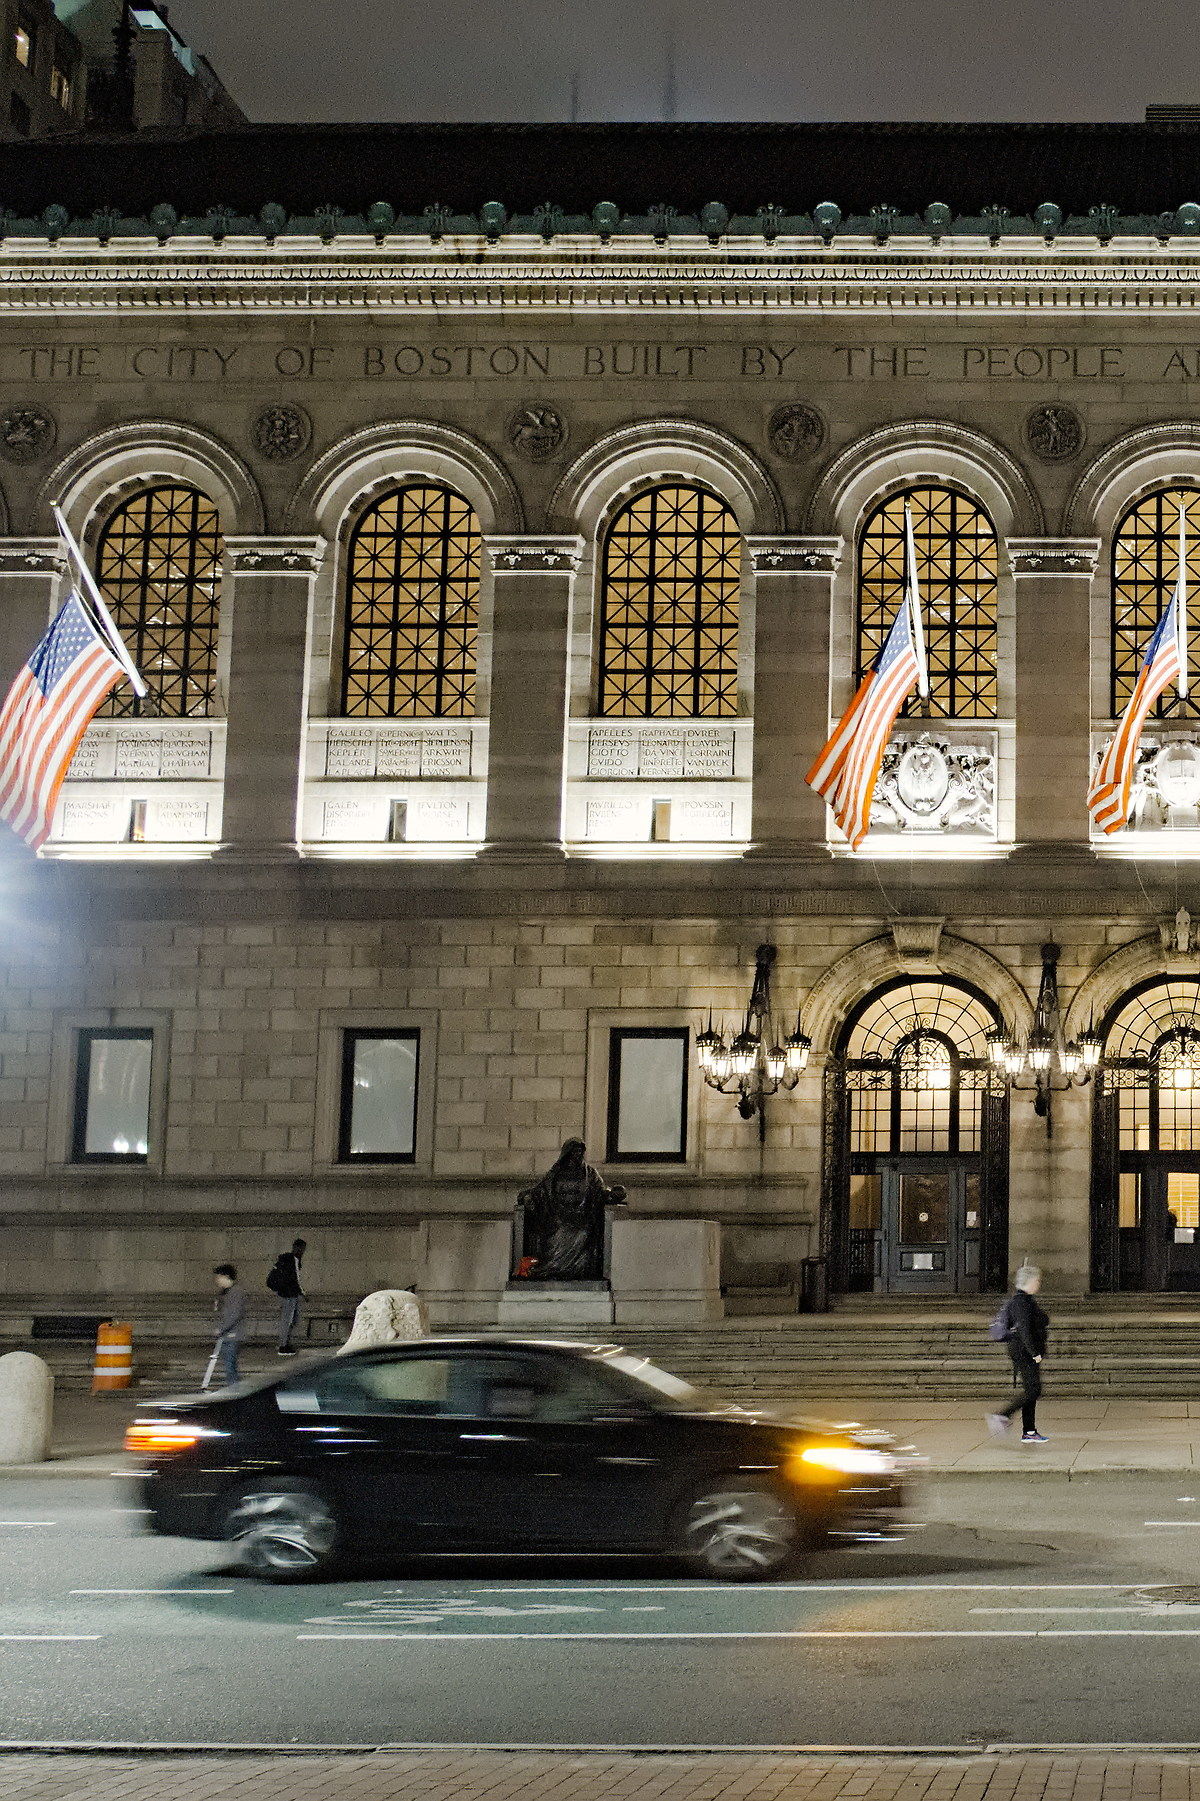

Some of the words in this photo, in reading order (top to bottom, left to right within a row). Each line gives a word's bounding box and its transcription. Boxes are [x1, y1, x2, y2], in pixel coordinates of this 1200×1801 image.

[20, 347, 101, 377] THE
[131, 347, 239, 377] CITY
[275, 347, 335, 376] OF
[364, 346, 550, 376] BOSTON
[583, 346, 707, 376] BUILT
[740, 346, 798, 376] BY
[834, 347, 930, 377] THE
[963, 347, 1126, 378] PEOPLE
[85, 730, 111, 738] OATE
[164, 730, 193, 738] COKE
[330, 729, 372, 738] GALILEO
[424, 729, 458, 737] WATTS
[591, 729, 633, 737] APELLES
[642, 729, 682, 737] RAPHAEL
[76, 750, 99, 758] TORY
[329, 748, 366, 757] KEPLER
[591, 748, 629, 757] GIOTTO
[422, 758, 462, 766] ERICSSON
[69, 769, 96, 777] KENT
[163, 769, 181, 777] FOX
[422, 768, 451, 776] EVANS
[686, 768, 723, 777] MATSYS
[327, 801, 359, 809] GALEN
